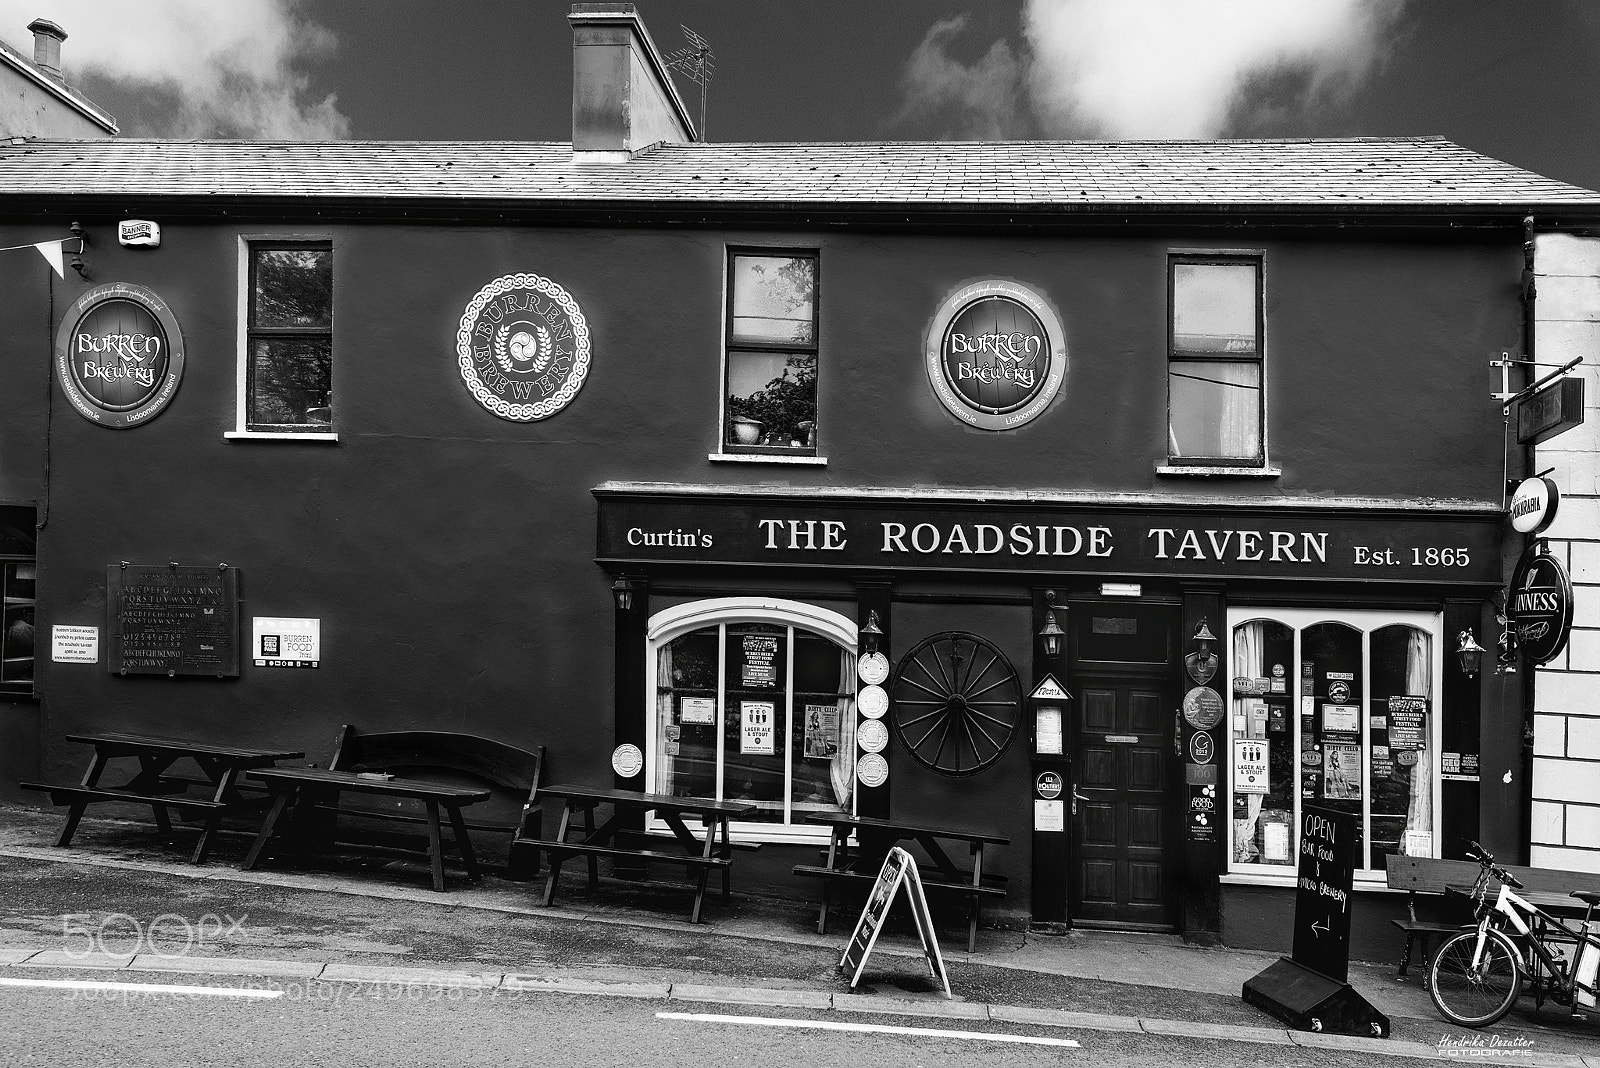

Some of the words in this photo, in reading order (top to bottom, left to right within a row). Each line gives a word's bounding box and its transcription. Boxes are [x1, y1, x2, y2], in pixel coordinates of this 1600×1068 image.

[123, 225, 151, 234] BANNER
[475, 292, 573, 342] BURREN
[162, 374, 176, 397] Ireland
[474, 344, 573, 400] BREWERY
[1043, 374, 1059, 397] Ireland
[59, 356, 100, 421] www.roadsidetavern.ie
[930, 355, 977, 424] www.roadsidetavern.ie
[627, 527, 713, 548] Curtin's
[758, 519, 847, 550] THE
[880, 522, 1114, 557] ROADSIDE
[1147, 528, 1329, 563] TAVERN
[1353, 546, 1400, 566] Est.
[1411, 547, 1470, 567] 1865
[287, 643, 312, 651] FOOD
[1442, 758, 1460, 766] GEO
[1305, 814, 1336, 845] OPEN
